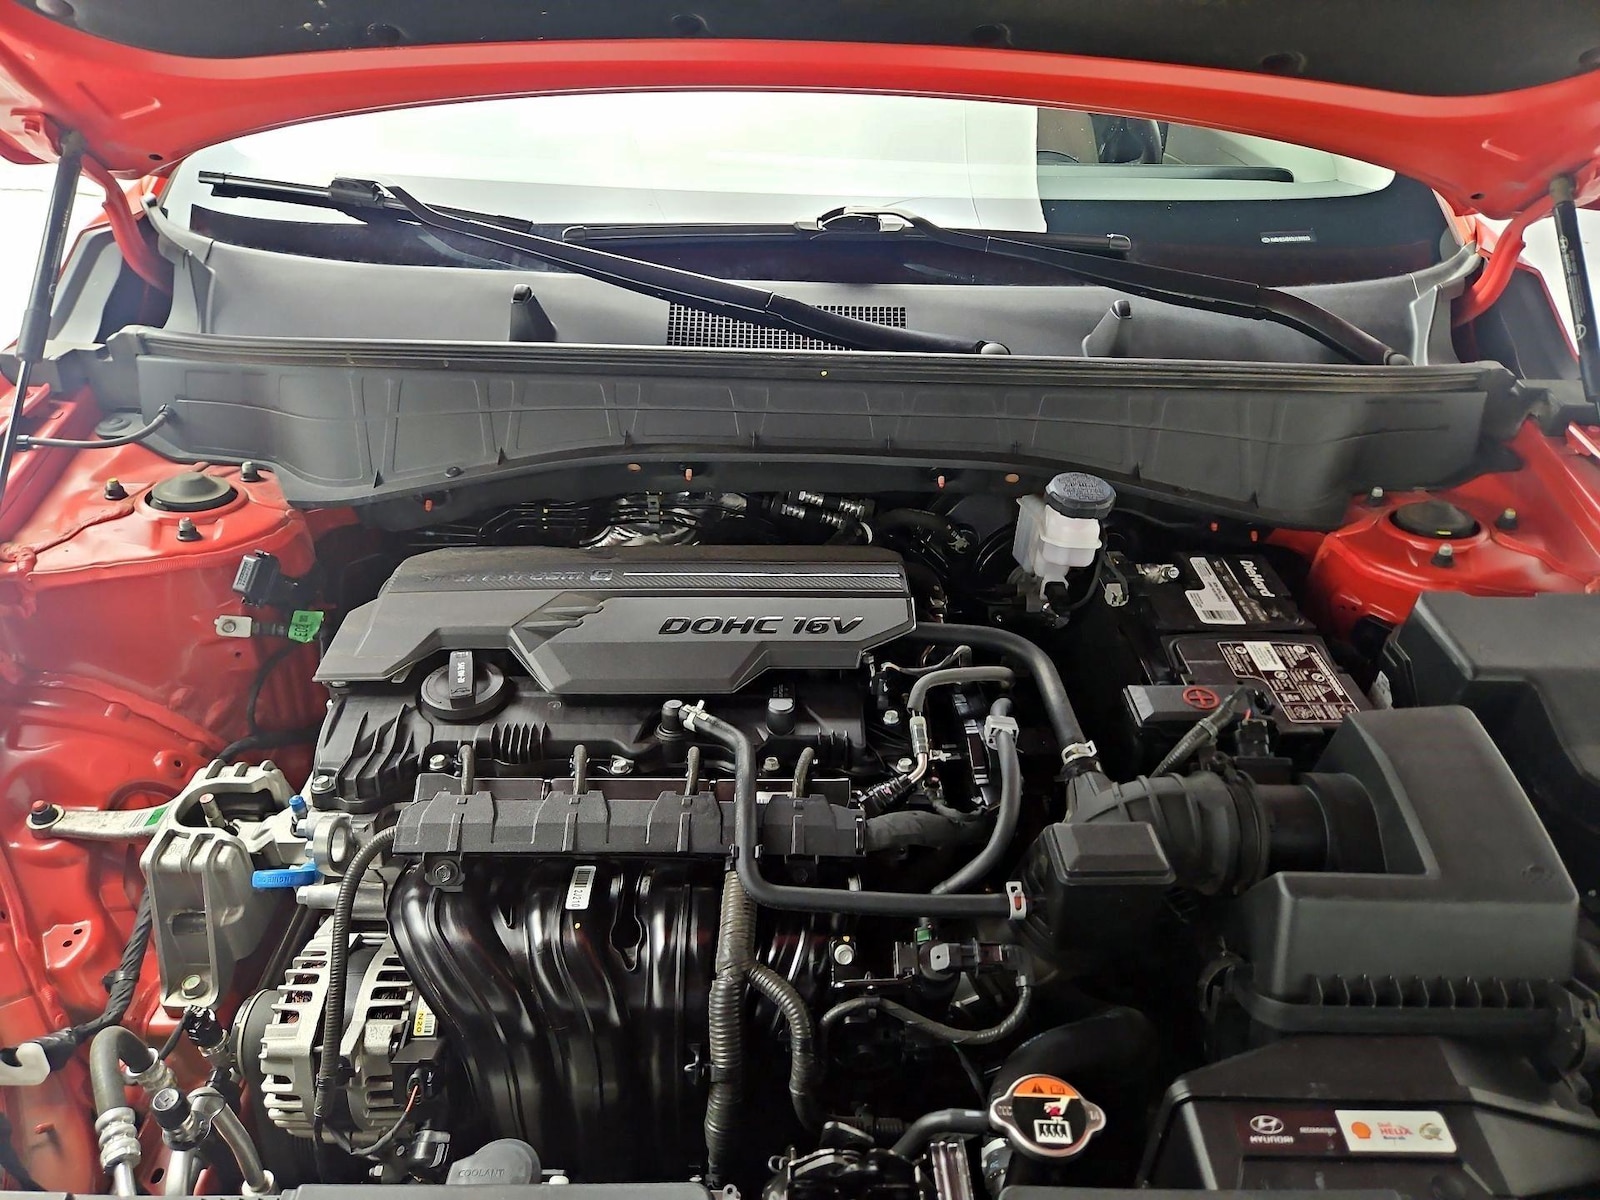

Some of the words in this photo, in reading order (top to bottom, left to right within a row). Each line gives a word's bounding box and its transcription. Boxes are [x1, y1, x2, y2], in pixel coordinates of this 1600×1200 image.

[1239, 559, 1276, 598] DieHard
[658, 616, 785, 635] DOHC
[792, 616, 864, 635] 16V
[457, 1167, 505, 1179] COOLANT
